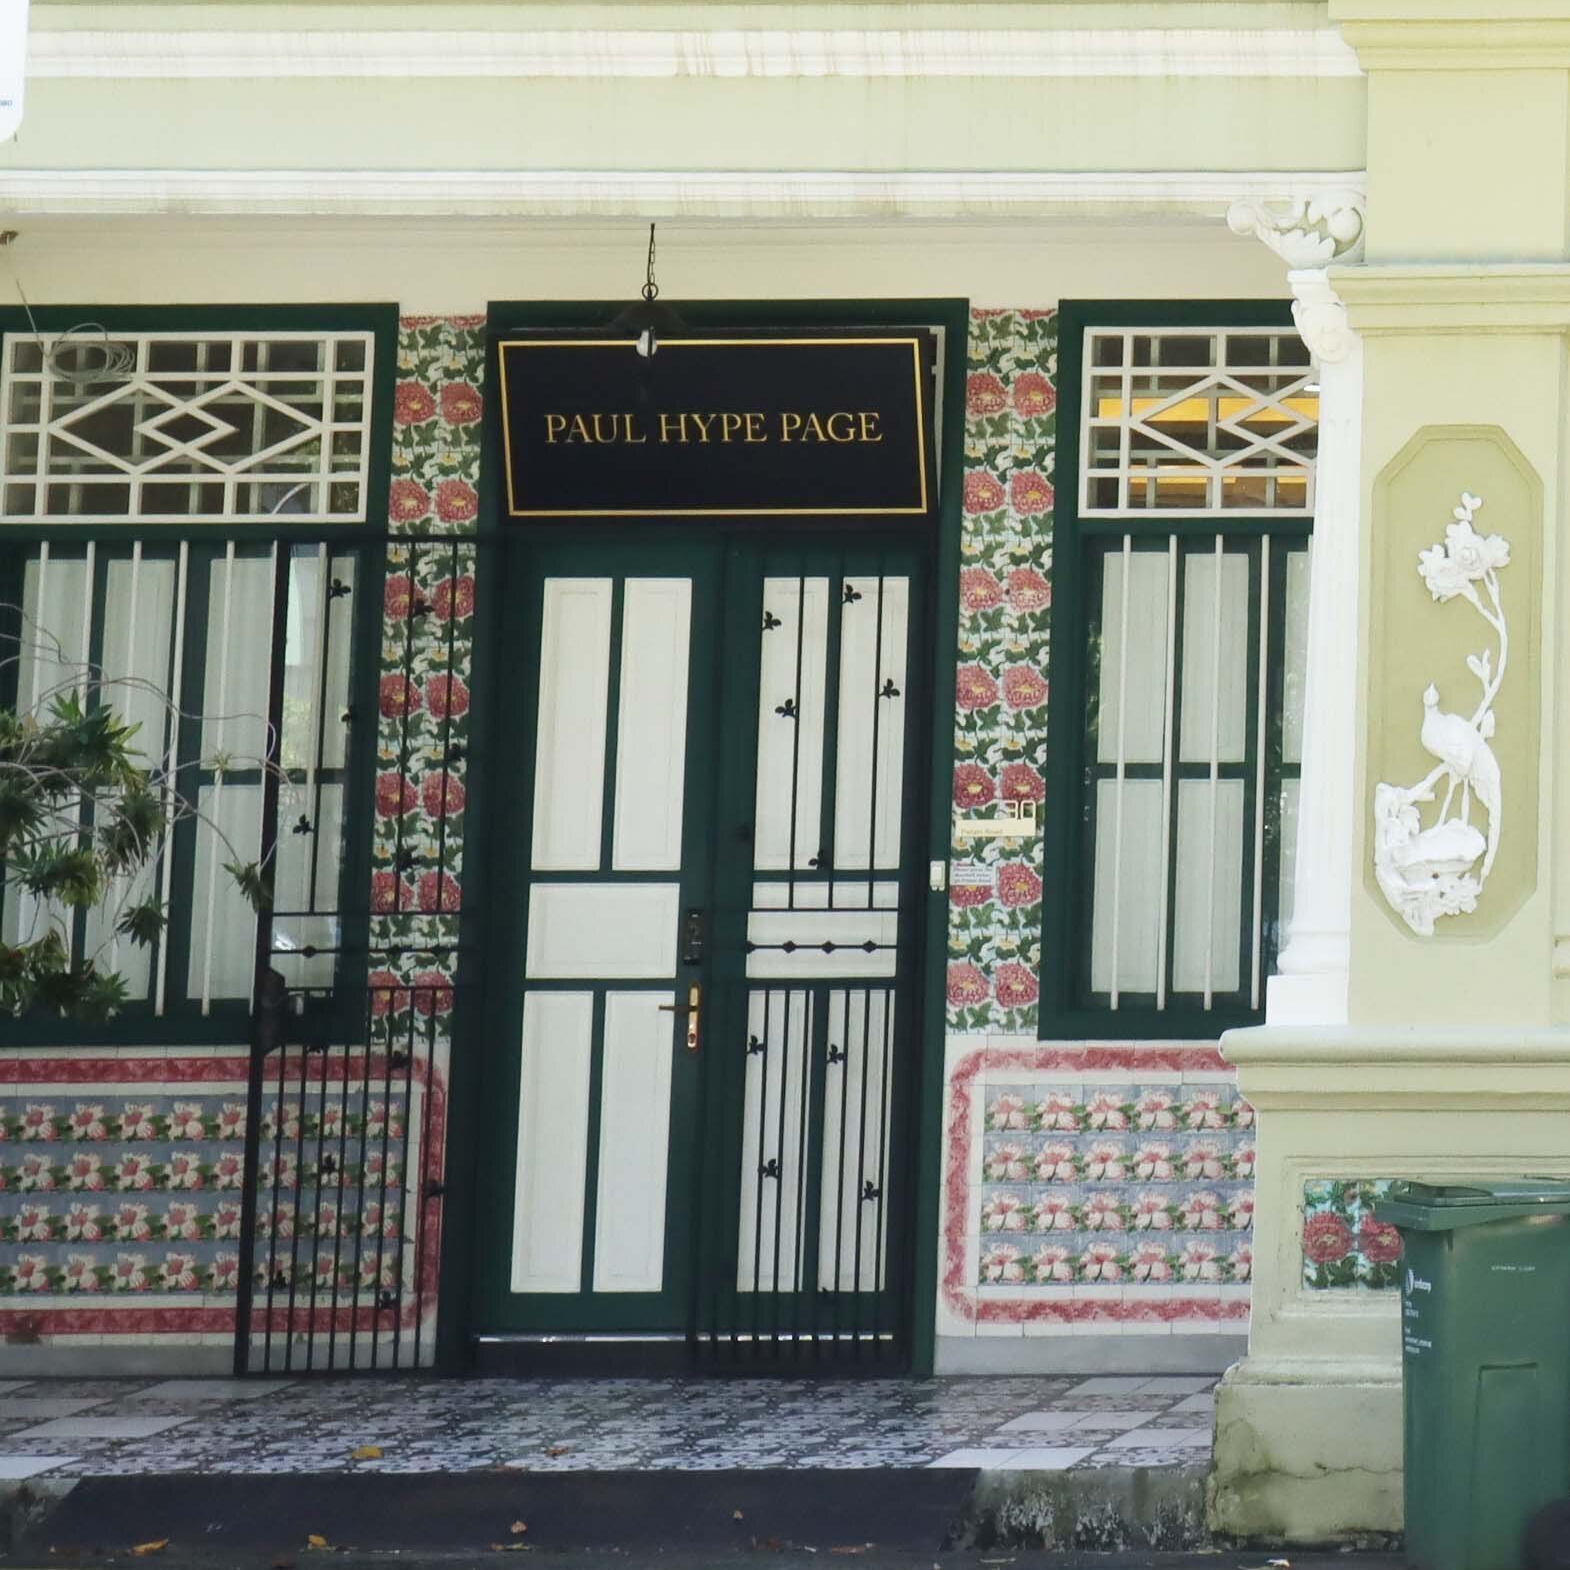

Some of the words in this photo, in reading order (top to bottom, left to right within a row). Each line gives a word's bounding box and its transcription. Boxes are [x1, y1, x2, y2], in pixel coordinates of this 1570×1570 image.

[544, 413, 647, 443] PAUL
[658, 413, 768, 443] HYPE
[779, 412, 884, 442] PAGE
[1003, 800, 1036, 820] 30
